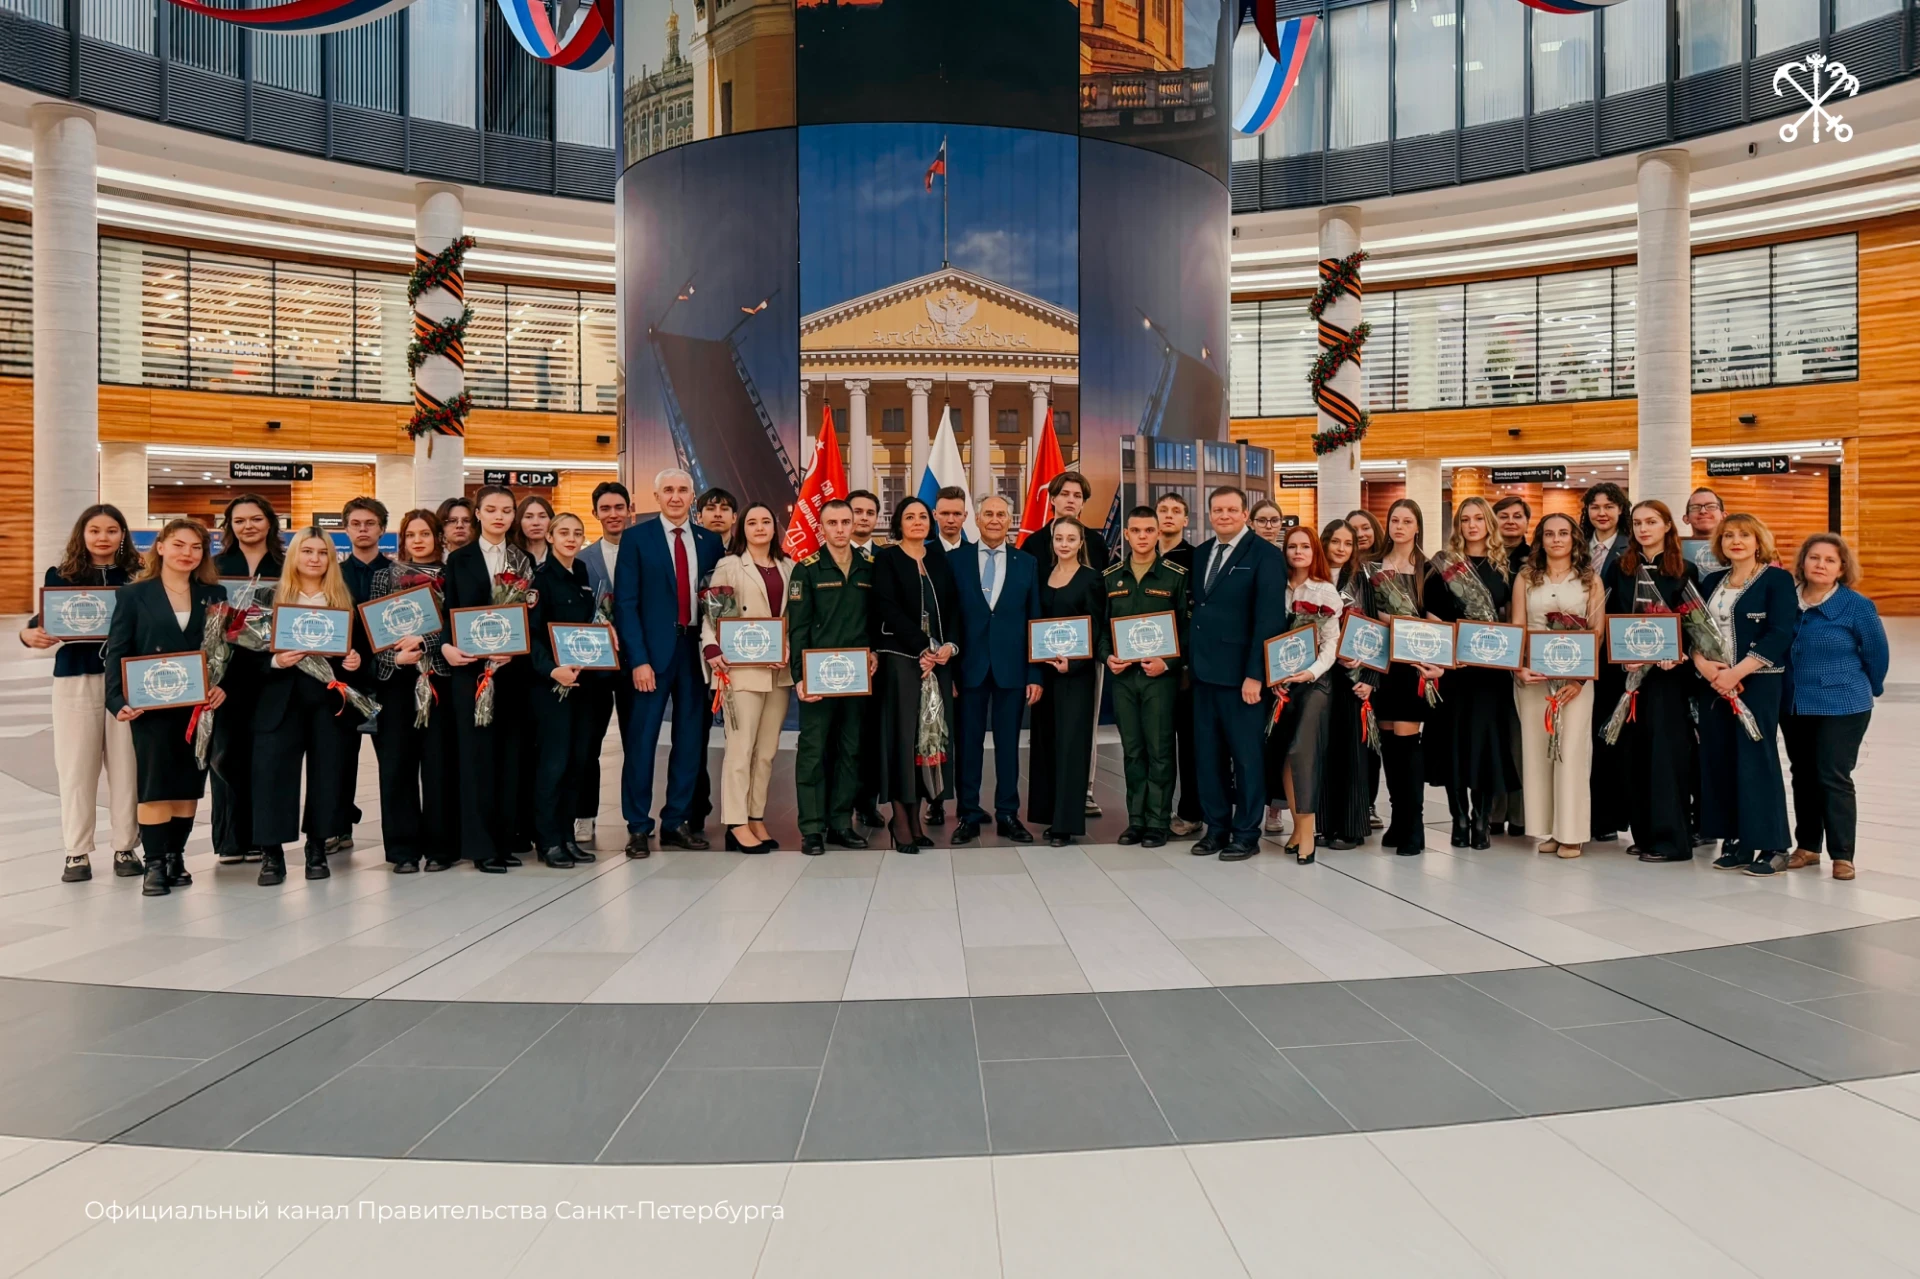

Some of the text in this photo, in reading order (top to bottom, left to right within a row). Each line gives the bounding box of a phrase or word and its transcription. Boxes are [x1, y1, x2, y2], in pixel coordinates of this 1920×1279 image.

[234, 463, 288, 471] Общественные
[1758, 461, 1772, 469] №3
[234, 470, 271, 478] приёмные
[821, 479, 834, 496] 150
[786, 521, 806, 546] 79
